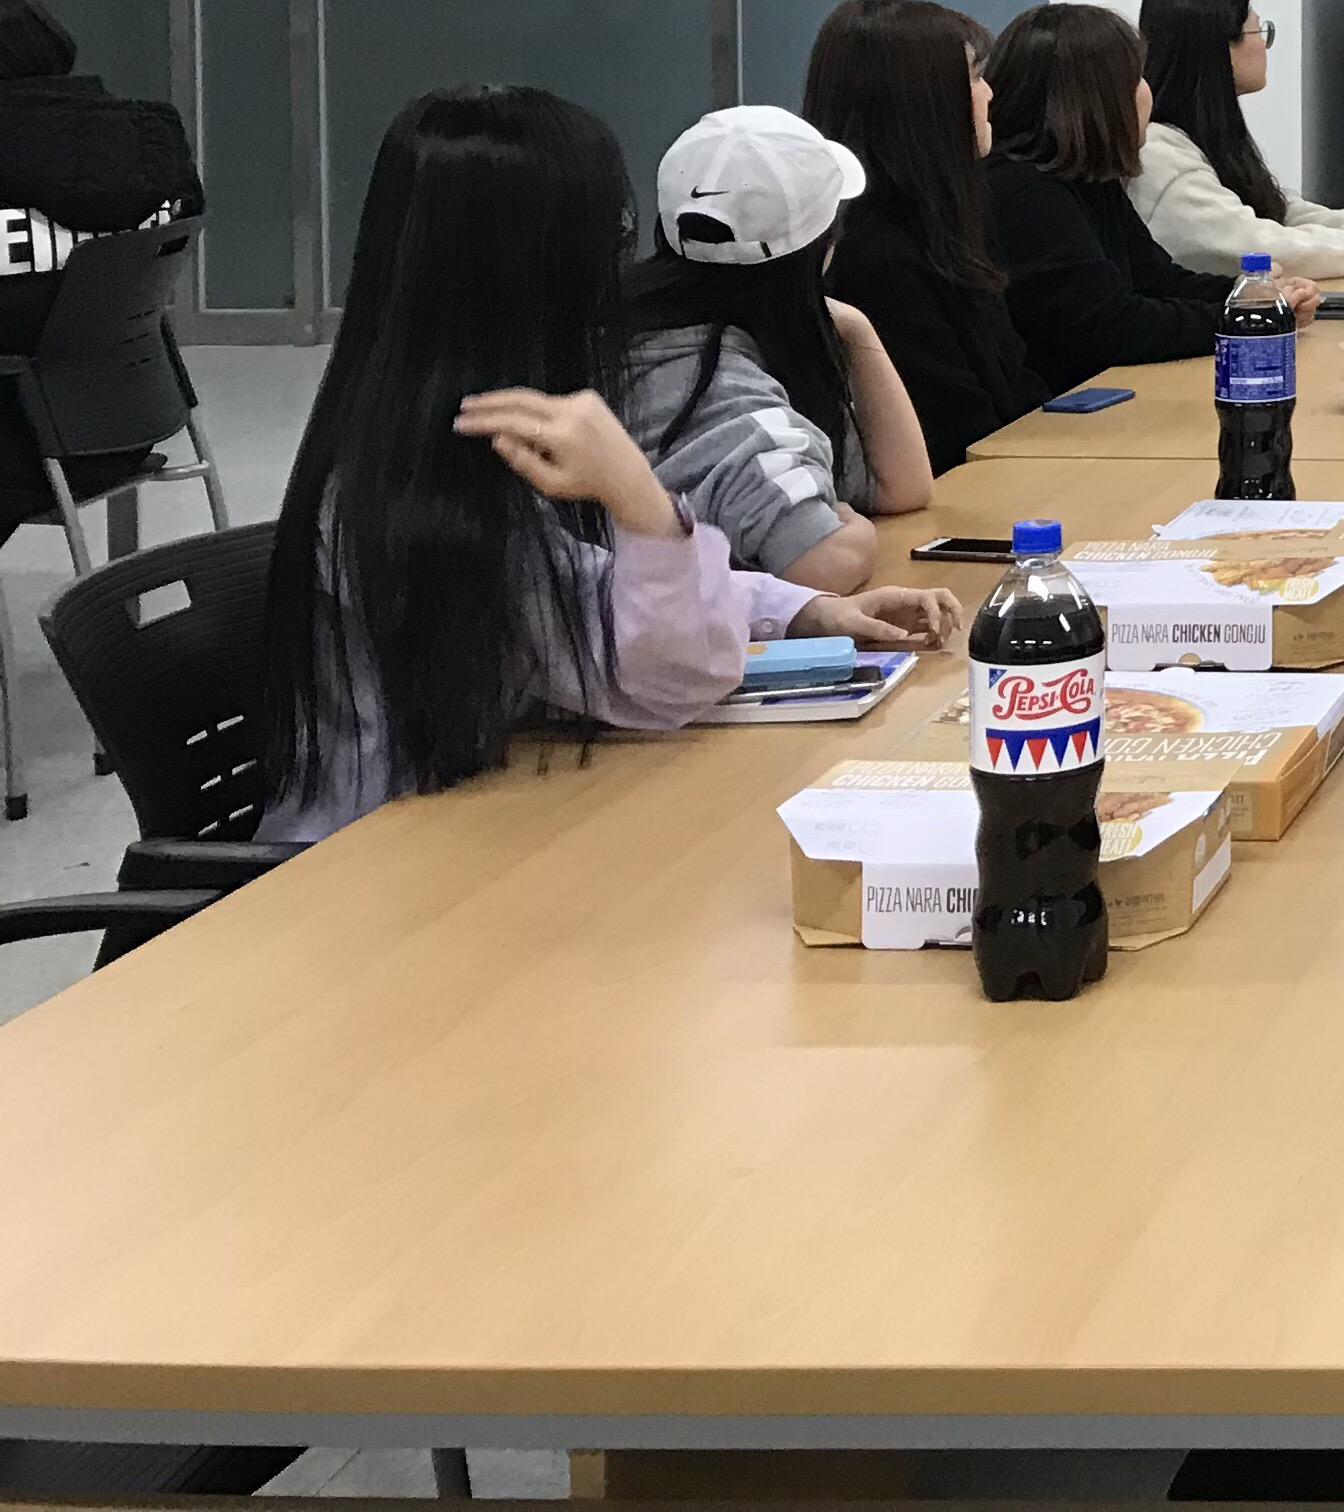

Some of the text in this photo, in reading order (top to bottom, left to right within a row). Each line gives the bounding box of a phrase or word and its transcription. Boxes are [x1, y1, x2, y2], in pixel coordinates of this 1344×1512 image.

[1112, 623, 1139, 644] PIZZA
[1142, 623, 1169, 644] NARA
[1172, 623, 1222, 644] CHICKEN
[866, 886, 903, 914] PIZZA
[905, 886, 942, 914] NARA
